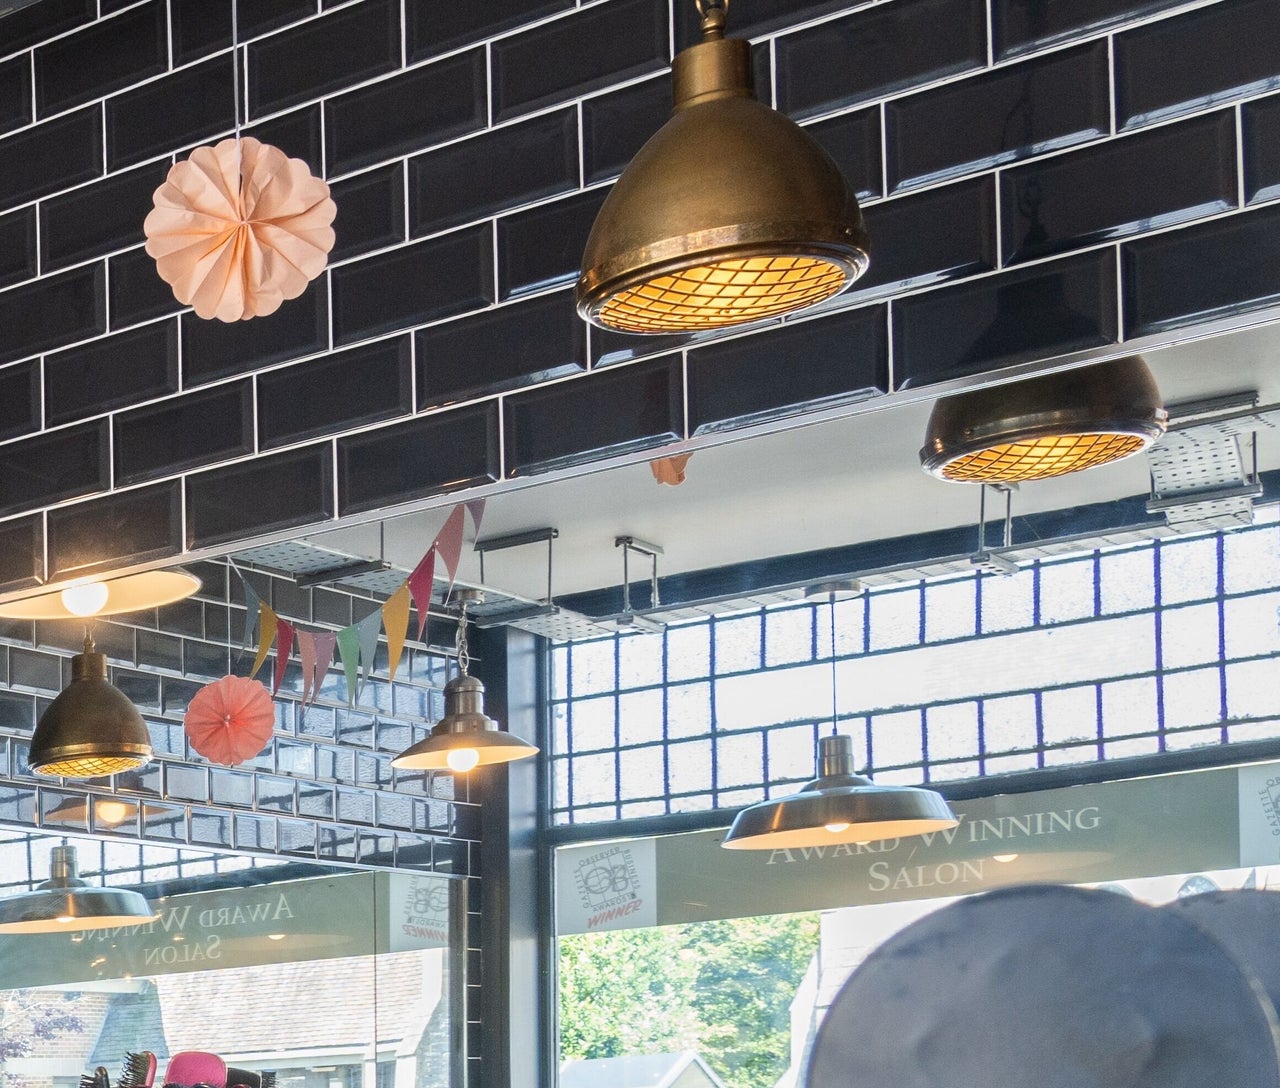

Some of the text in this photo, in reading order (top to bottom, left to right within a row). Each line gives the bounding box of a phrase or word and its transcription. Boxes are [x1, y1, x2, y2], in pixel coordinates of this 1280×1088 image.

[766, 806, 1102, 866] AWARD WINNING
[578, 846, 620, 866] OBSERVER
[868, 859, 984, 892] SALON
[587, 899, 643, 929] WINNER
